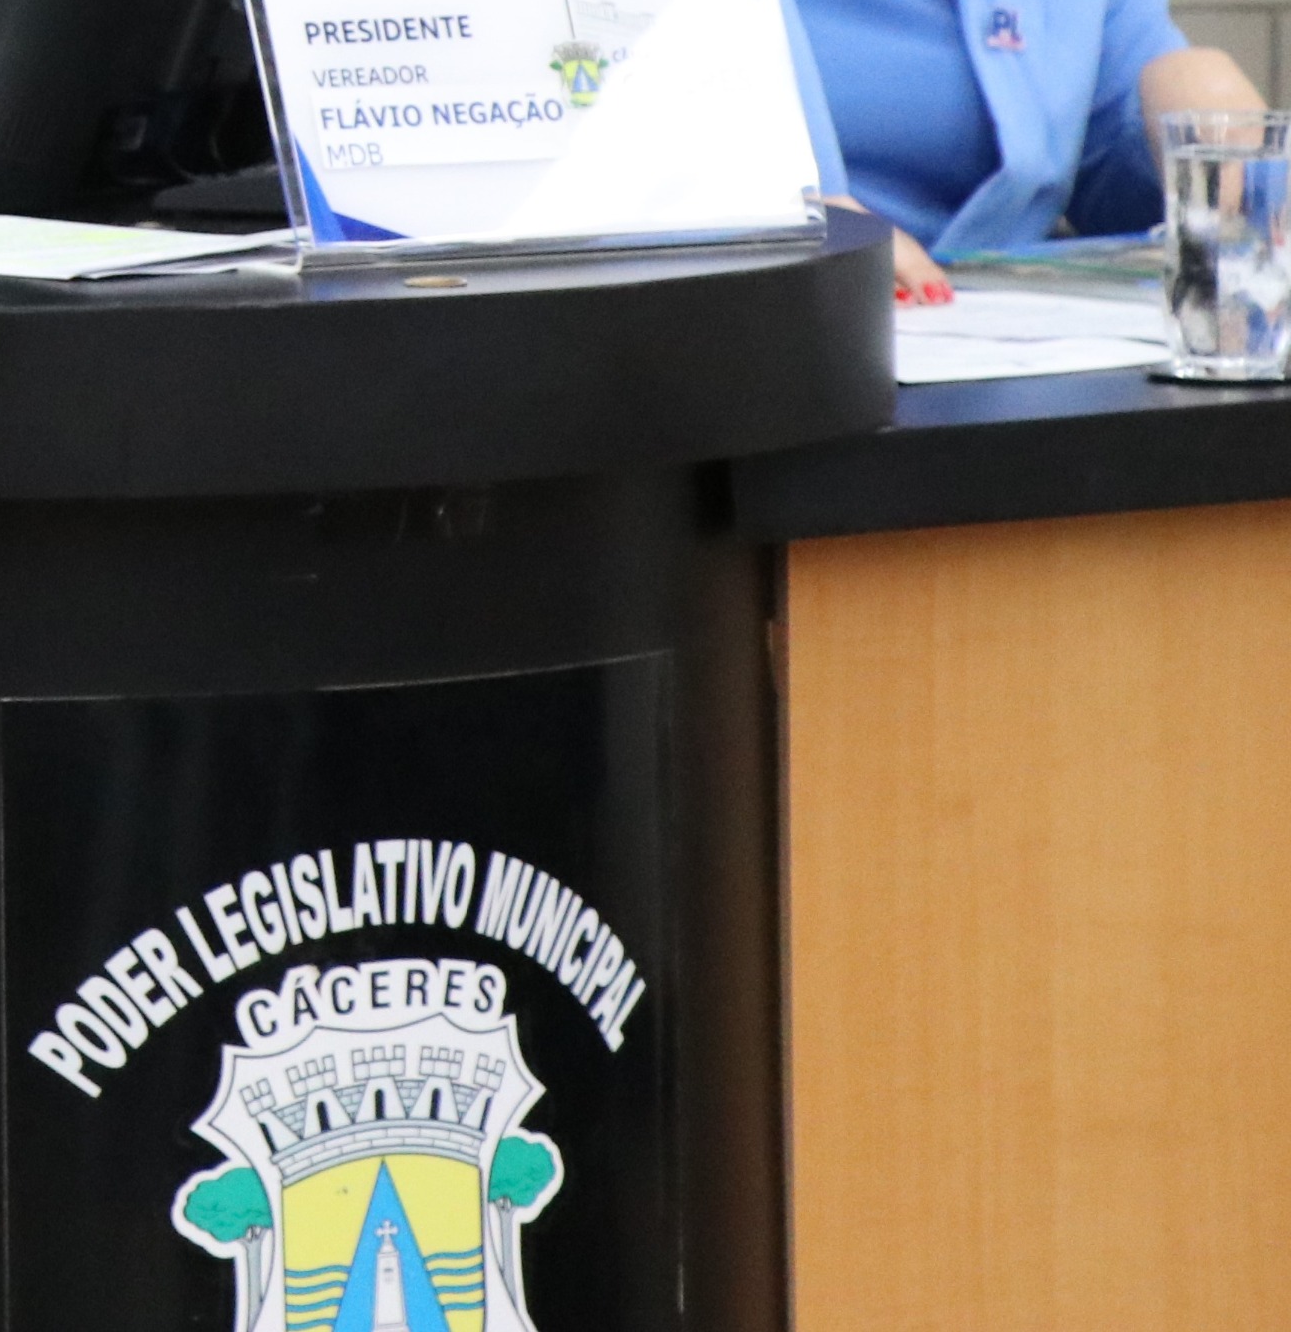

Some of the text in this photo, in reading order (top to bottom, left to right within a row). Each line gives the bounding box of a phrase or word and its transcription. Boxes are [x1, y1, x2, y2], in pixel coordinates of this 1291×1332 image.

[304, 15, 473, 45] PRESIDENTE
[312, 64, 429, 88] VEREADOR
[320, 93, 564, 130] FLÁVIO NEGAÇÃO
[326, 142, 384, 167] MDB
[28, 839, 647, 1099] PODER LEGISLATIVO MUNICIPAL
[248, 968, 497, 1037] CÁCERES
